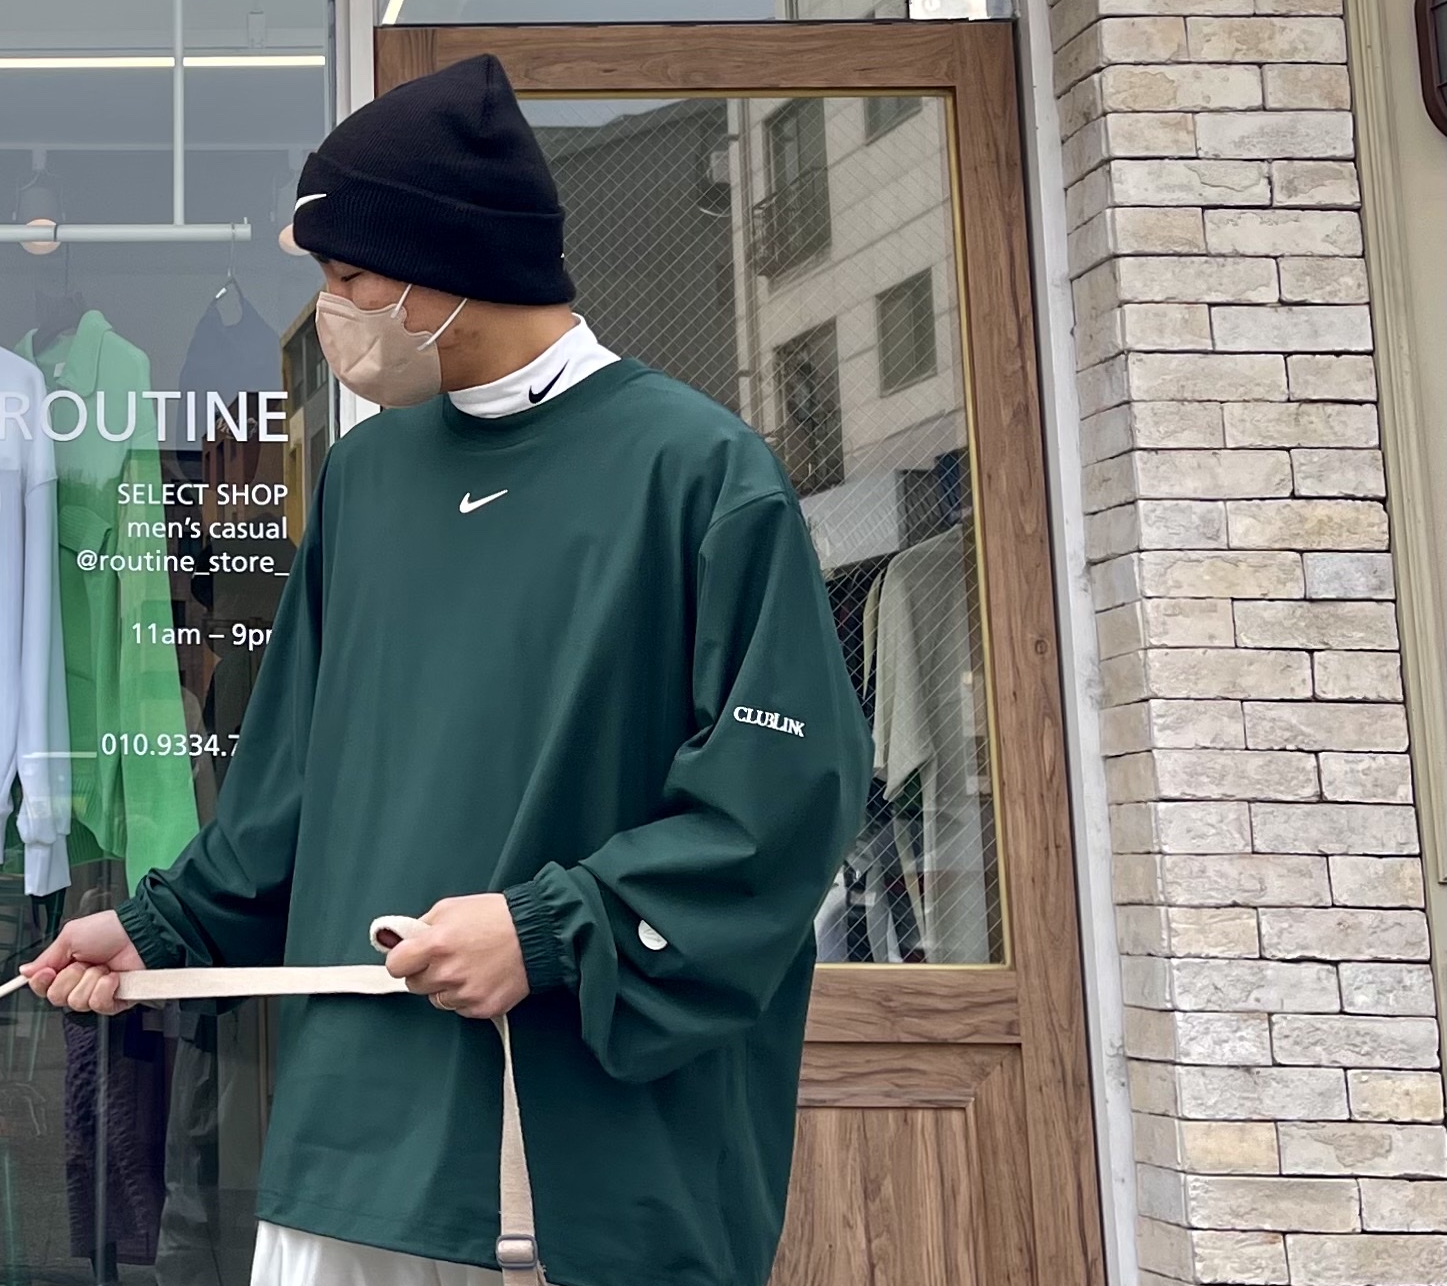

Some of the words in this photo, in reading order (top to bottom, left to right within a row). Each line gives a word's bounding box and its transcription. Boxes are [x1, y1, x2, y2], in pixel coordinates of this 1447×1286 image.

[117, 484, 210, 506] SELECT
[216, 484, 288, 506] SHOP
[127, 517, 201, 540] men's
[208, 517, 288, 540] casual
[76, 549, 290, 577] @routine_store_
[132, 622, 201, 645] 11am
[231, 623, 273, 652] 9p
[733, 706, 805, 737] CLUBLINK
[102, 732, 240, 757] 010.9334.7
